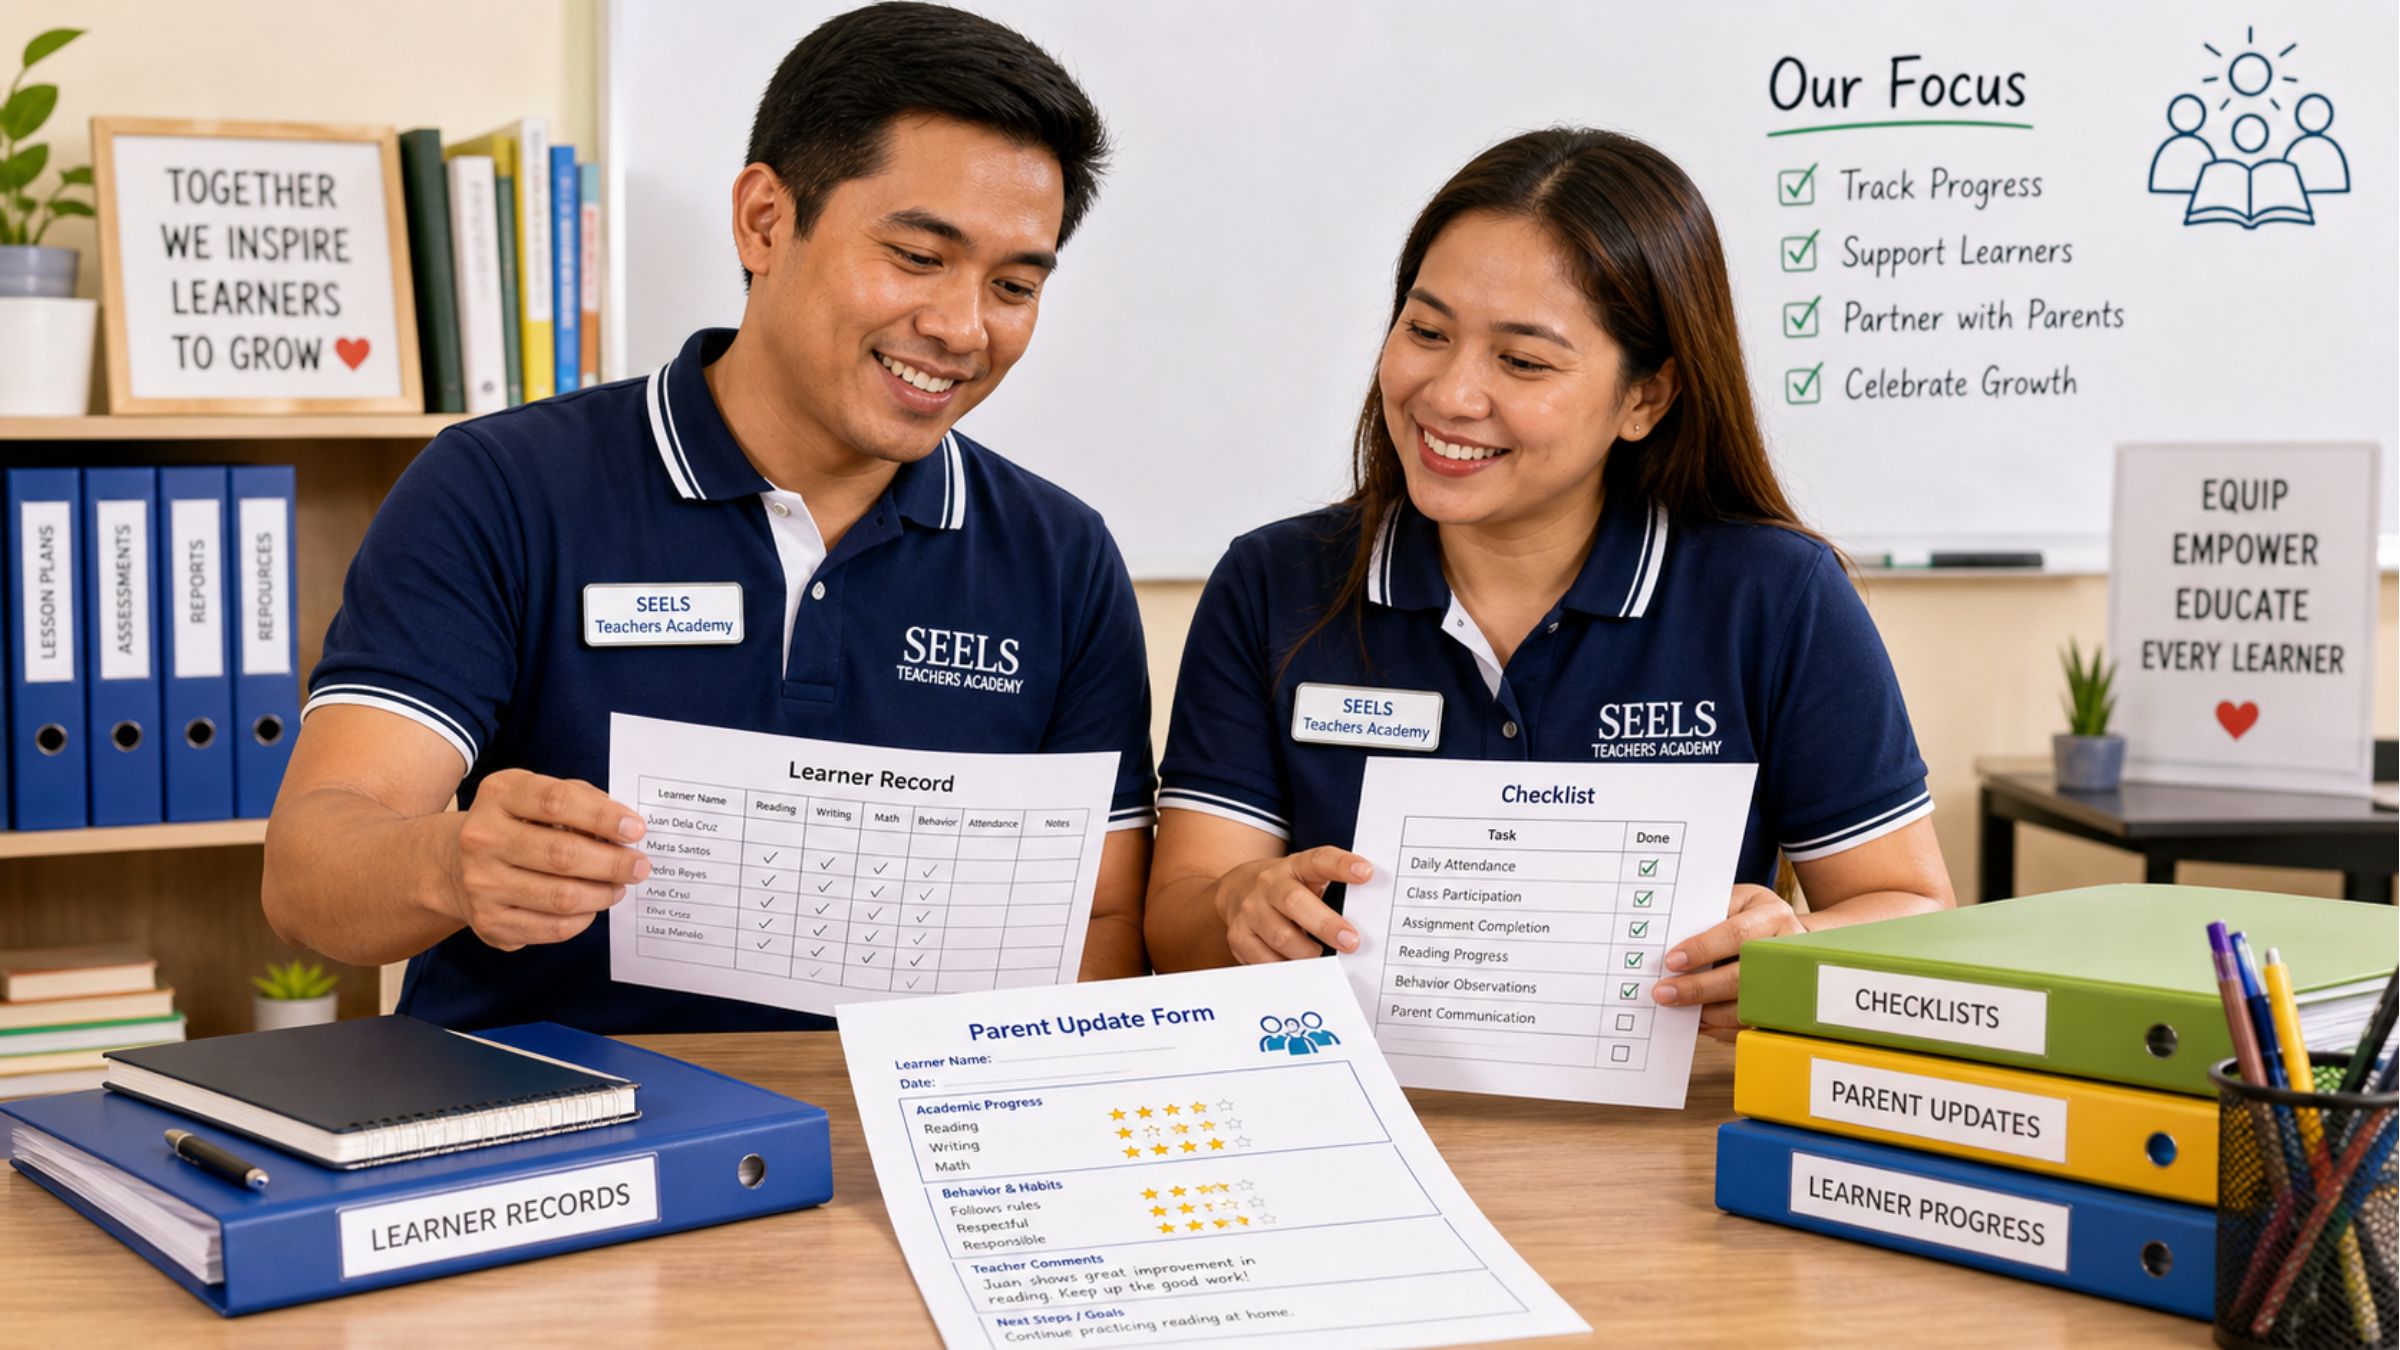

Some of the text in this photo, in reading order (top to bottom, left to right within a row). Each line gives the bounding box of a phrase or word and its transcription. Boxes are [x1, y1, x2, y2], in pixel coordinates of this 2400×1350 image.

[1769, 55, 2027, 111] Our Focus
[166, 168, 336, 208] TOGETHER
[1840, 168, 2043, 210] Track Progress
[161, 223, 351, 263] WE INSPIRE
[1841, 235, 2074, 277] Support Learners
[172, 280, 341, 317] LEARNERS
[1843, 299, 2125, 333] Partner with Parents
[172, 335, 322, 371] TO GROW
[1845, 364, 2078, 399] Celebrate Growth
[2202, 478, 2289, 512] EQUIP
[2173, 533, 2319, 566] EMPOWER
[115, 524, 132, 655] ASSESSMENTS
[190, 539, 206, 624] REPORTS
[40, 525, 56, 660] LESSON PLANS
[636, 596, 691, 613] SEELS
[2175, 588, 2309, 621] EDUCATE
[595, 619, 733, 636] Teachers Academy
[904, 627, 1019, 675] SEELS
[2142, 640, 2345, 674] EVERY LEARNER
[897, 665, 1023, 695] TEACHERS ACADEMY
[1343, 698, 1393, 716] SEELS
[1303, 717, 1430, 742] Teachers Academy
[1599, 701, 1717, 740] SEELS
[1592, 740, 1722, 758] TEACHERS ACADEMY
[789, 761, 954, 792] Learner Record
[658, 789, 727, 806] Learner Name
[1501, 785, 1596, 805] Checklist
[756, 801, 796, 816] Reading
[816, 808, 851, 821] Writing
[875, 813, 900, 823] Math
[918, 816, 957, 827] Behavior
[968, 819, 1018, 828] Attendance
[1045, 819, 1070, 828] Notes
[1488, 829, 1516, 841] Task
[1636, 832, 1670, 844] Done
[652, 865, 675, 876] edro
[1411, 858, 1516, 873] Daily Attendance
[1407, 888, 1522, 904] Class Participation
[1402, 917, 1550, 935] Assignment Completion
[1399, 946, 1508, 965] Reading Progress
[1395, 975, 1537, 994] Behavior Observations
[1391, 1005, 1536, 1024] Parent Communication
[1855, 987, 2000, 1030] CHECKLISTS
[969, 1006, 1215, 1041] Parent Update Form
[895, 1053, 992, 1071] Learner Name:
[900, 1078, 936, 1090] Date:
[916, 1097, 1043, 1115] Academic Progress
[1831, 1080, 2041, 1139] PARENT UPDATES
[924, 1121, 979, 1135] Reading
[929, 1140, 980, 1154] Writing
[935, 1160, 971, 1172] Math
[942, 1180, 1063, 1199] Behavior & Habits
[1006, 1201, 1041, 1212] rules
[1808, 1175, 2046, 1247] LEARNER PROGRESS
[371, 1181, 631, 1253] LEARNER RECORDS
[971, 1254, 1105, 1275] Teacher Comments
[983, 1256, 1256, 1290] Juan shows great improvement in
[989, 1271, 1250, 1305] reading. Keep up the good work!
[1085, 1309, 1125, 1321] Goals
[1005, 1309, 1294, 1343] Continue practicing reading at home.
